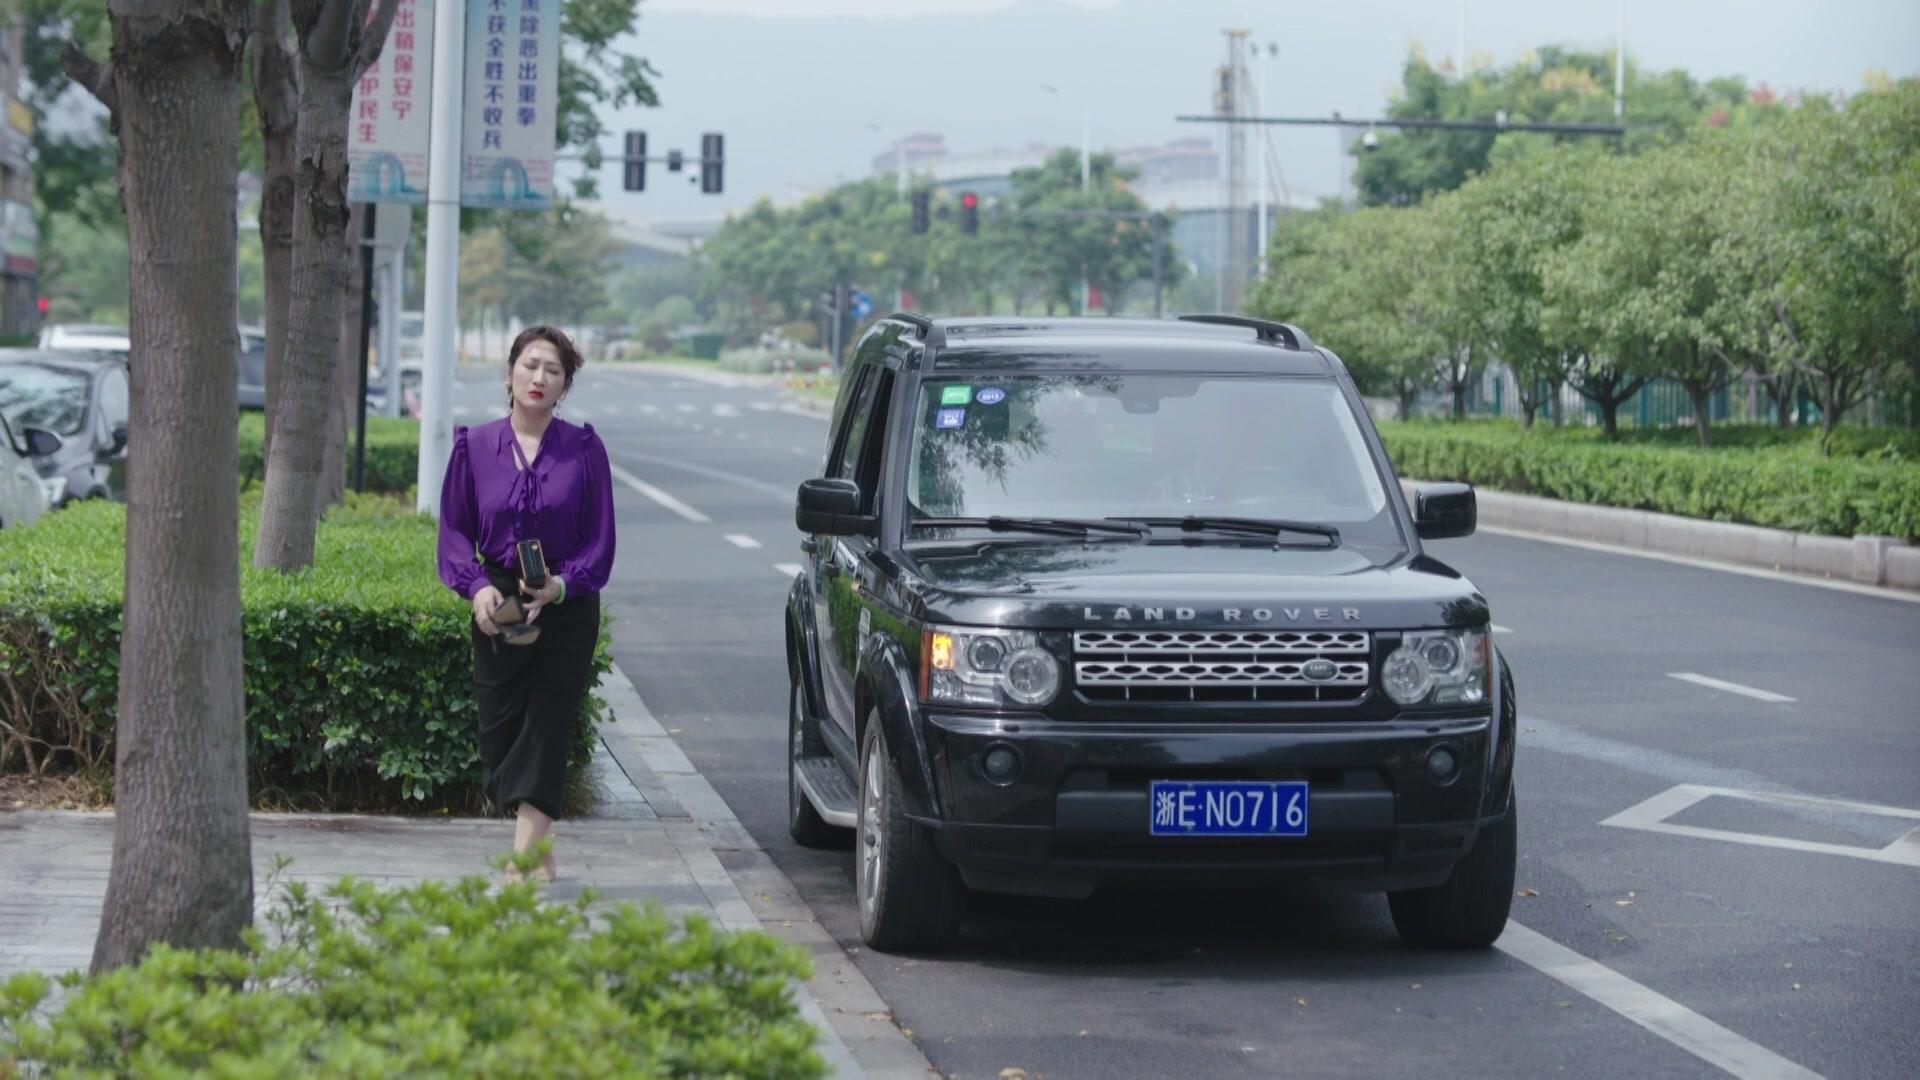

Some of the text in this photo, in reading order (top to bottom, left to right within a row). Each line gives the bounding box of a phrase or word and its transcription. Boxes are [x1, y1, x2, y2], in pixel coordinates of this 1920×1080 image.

[392, 0, 416, 120] 出鞘保安宁
[1084, 606, 1361, 622] LAND ROVER
